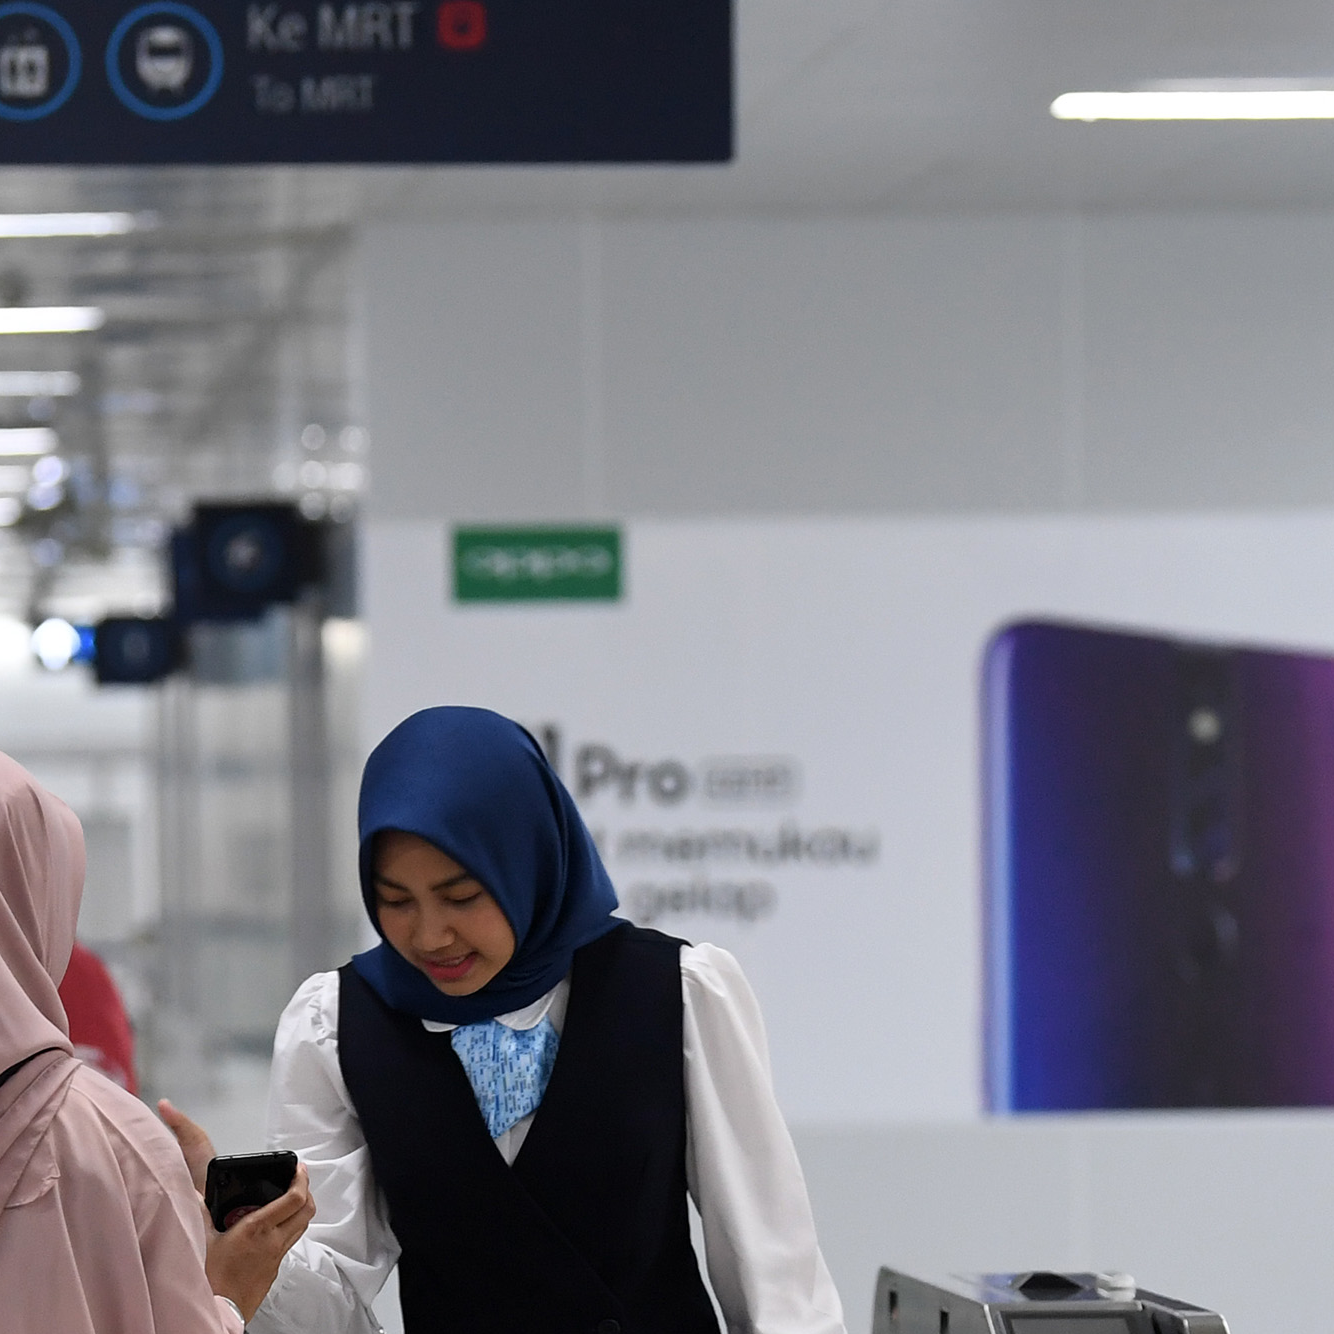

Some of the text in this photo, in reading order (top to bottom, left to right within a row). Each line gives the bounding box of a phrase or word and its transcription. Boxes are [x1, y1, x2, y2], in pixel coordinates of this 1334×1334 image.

[247, 2, 417, 50] Ke MRT
[574, 745, 691, 806] Pro
